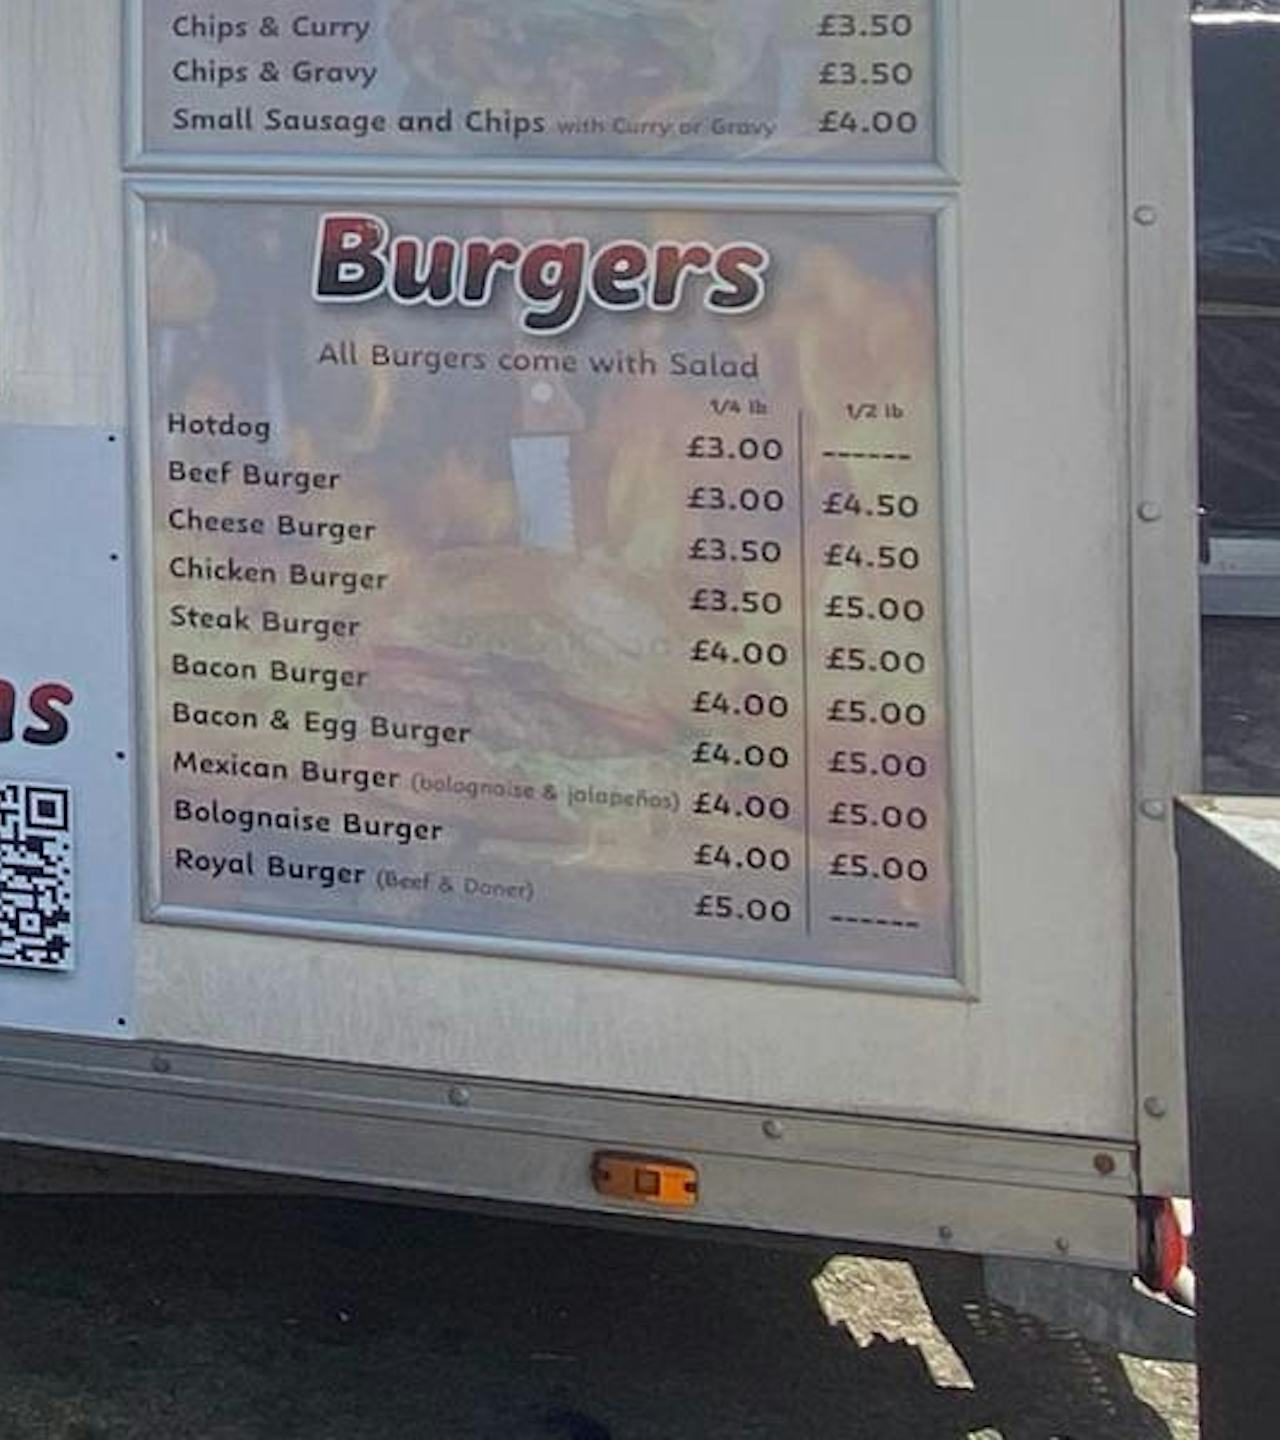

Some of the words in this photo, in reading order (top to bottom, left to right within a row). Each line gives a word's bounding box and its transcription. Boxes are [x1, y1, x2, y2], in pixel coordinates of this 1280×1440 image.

[172, 15, 248, 40] Chips
[259, 16, 279, 35] &
[292, 15, 370, 41] Curry
[818, 13, 912, 36] £3.50
[172, 59, 248, 86] Chips
[259, 61, 279, 79] &
[292, 61, 377, 86] Gravy
[819, 62, 914, 84] £3.50
[172, 107, 252, 130] Small
[264, 107, 386, 134] Sausage
[398, 108, 453, 130] and
[464, 108, 546, 135] Chips
[819, 110, 917, 133] £4.00
[312, 210, 772, 333] Burgers
[318, 341, 358, 364] All
[371, 343, 486, 373] Burgers
[498, 349, 577, 371] come
[589, 348, 658, 373] with
[670, 351, 758, 377] Salad
[749, 400, 768, 415] lb
[846, 403, 878, 420] 1/2
[884, 404, 904, 418] lb
[167, 413, 271, 439] Hotdog
[687, 435, 783, 459] £3.00
[168, 461, 233, 483] Beef
[243, 464, 340, 491] Burger
[688, 486, 784, 510] £3.00
[822, 492, 918, 516] £4.50
[168, 509, 266, 532] Cheese
[277, 514, 376, 540] Burger
[689, 538, 782, 561] £3.50
[823, 544, 920, 568] £4.50
[170, 556, 277, 582] Chicken
[287, 563, 388, 590] Burger
[690, 589, 783, 612] £3.50
[826, 596, 924, 621] £5.00
[170, 605, 251, 629] Steak
[262, 610, 360, 638] Burger
[690, 639, 788, 665] £4.00
[826, 647, 926, 673] £5.00
[172, 654, 260, 678] Bacon
[270, 659, 369, 687] Burger
[691, 691, 789, 716] £4.00
[827, 700, 926, 724] £5.00
[172, 702, 258, 726] Bacon
[269, 707, 290, 728] &
[304, 710, 358, 740] Egg
[369, 715, 471, 744] Burger
[692, 743, 789, 767] £4.00
[828, 752, 927, 777] £5.00
[173, 752, 288, 779] Mexican
[301, 758, 401, 789] Burger
[542, 782, 560, 800] &
[693, 793, 790, 818] £4.00
[829, 802, 927, 828] £5.00
[173, 799, 331, 831] Bolognaise
[342, 810, 444, 841] Burger
[694, 844, 791, 869] £4.00
[830, 854, 928, 880] £5.00
[174, 848, 256, 876] Royal
[267, 854, 366, 885] Burger
[375, 866, 432, 891] (Beef
[439, 871, 456, 891] &
[463, 874, 535, 900] Doner)
[695, 896, 792, 921] £5.00
